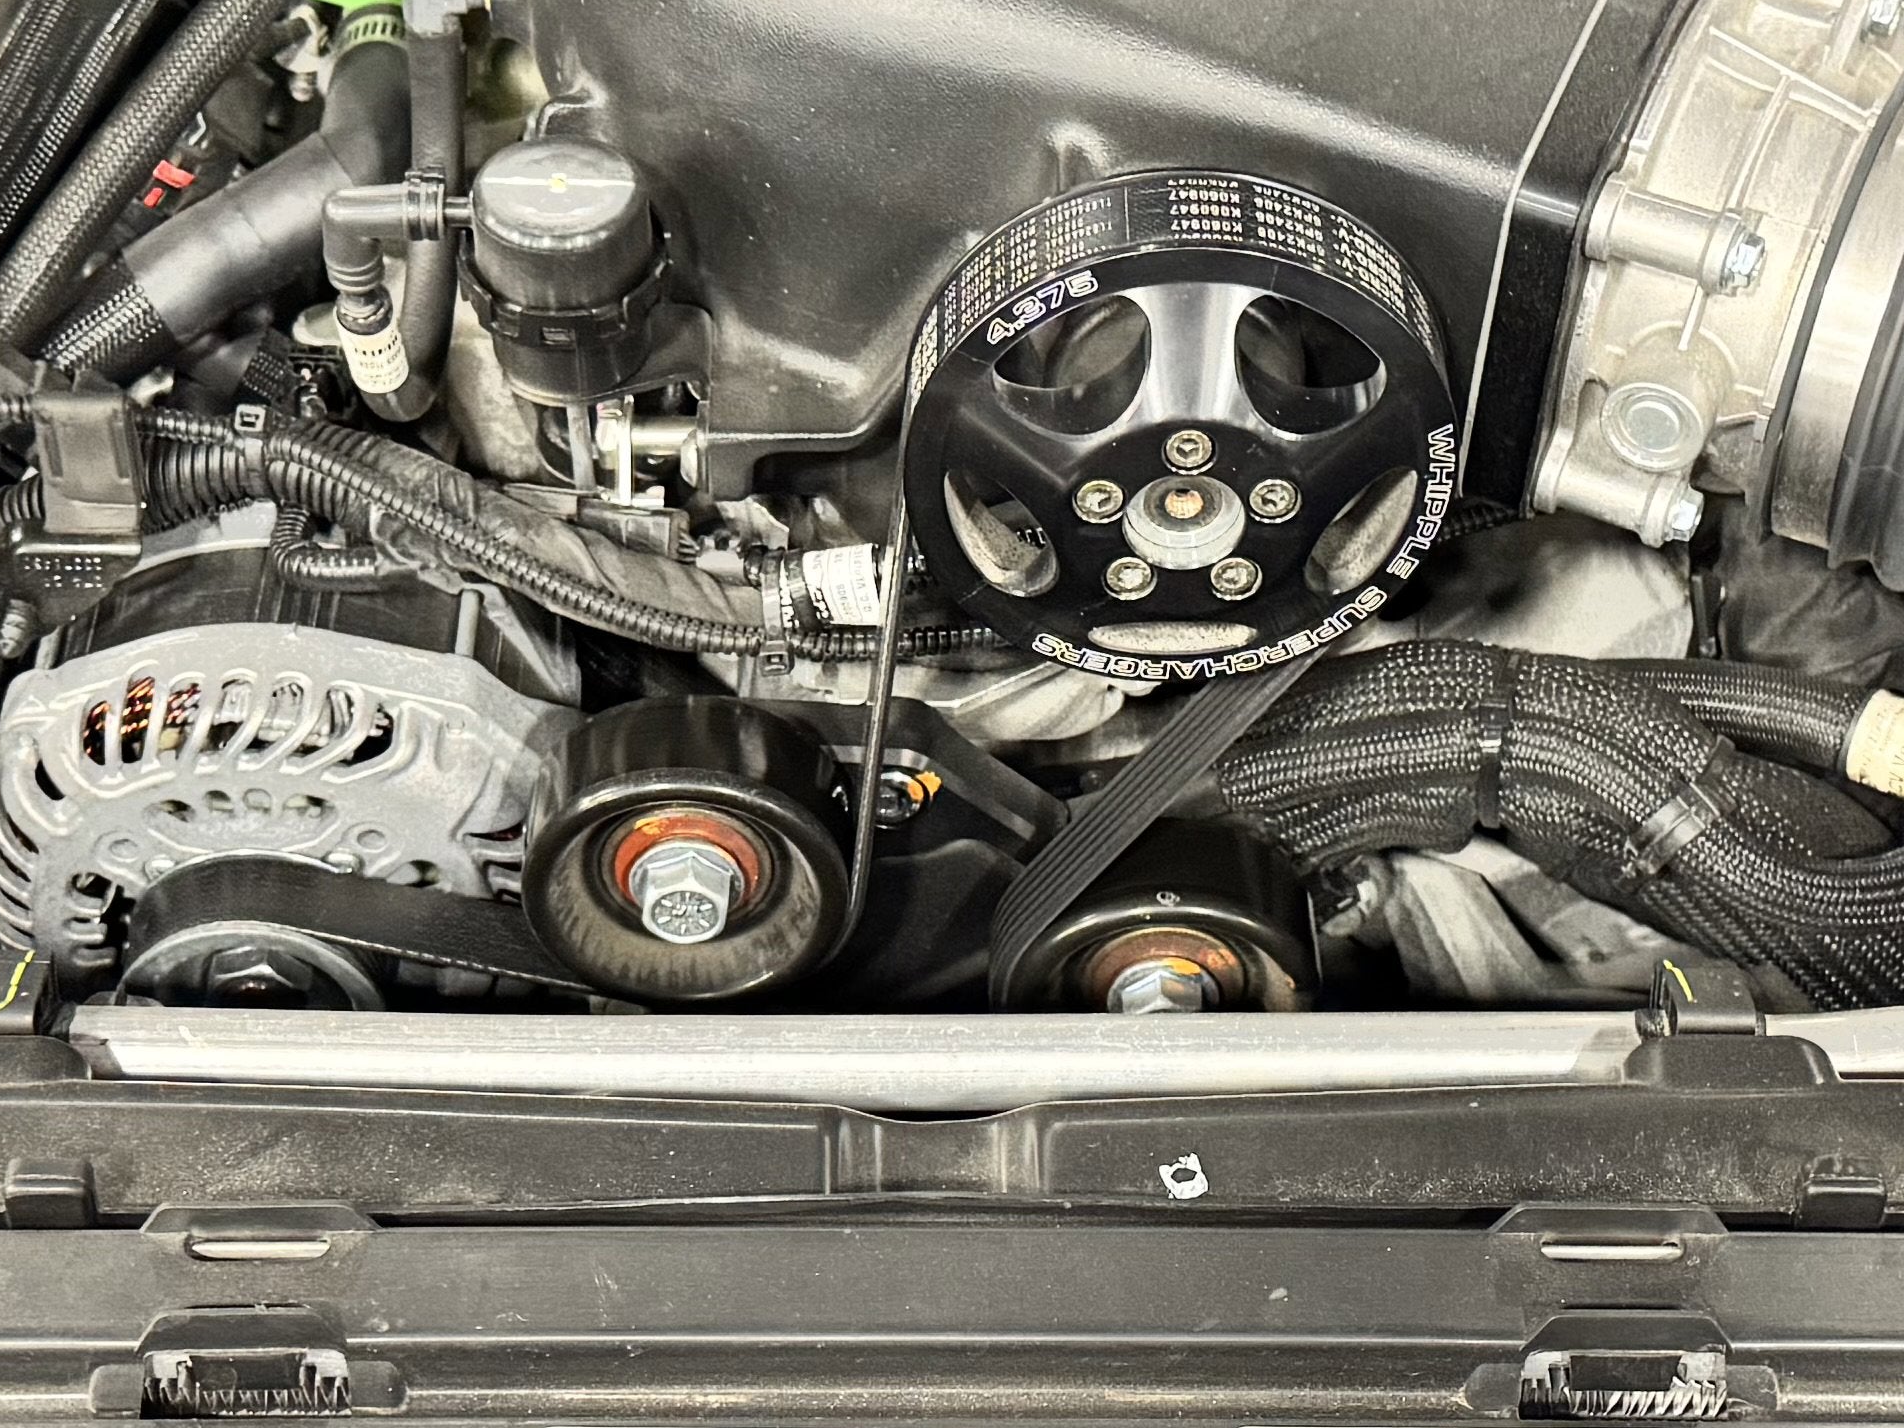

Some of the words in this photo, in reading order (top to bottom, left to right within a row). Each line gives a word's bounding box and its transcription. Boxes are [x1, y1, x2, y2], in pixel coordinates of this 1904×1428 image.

[986, 269, 1099, 345] 4.375
[1387, 424, 1456, 581] WHIPPLE
[1031, 585, 1389, 679] SUPERCHARGERS
